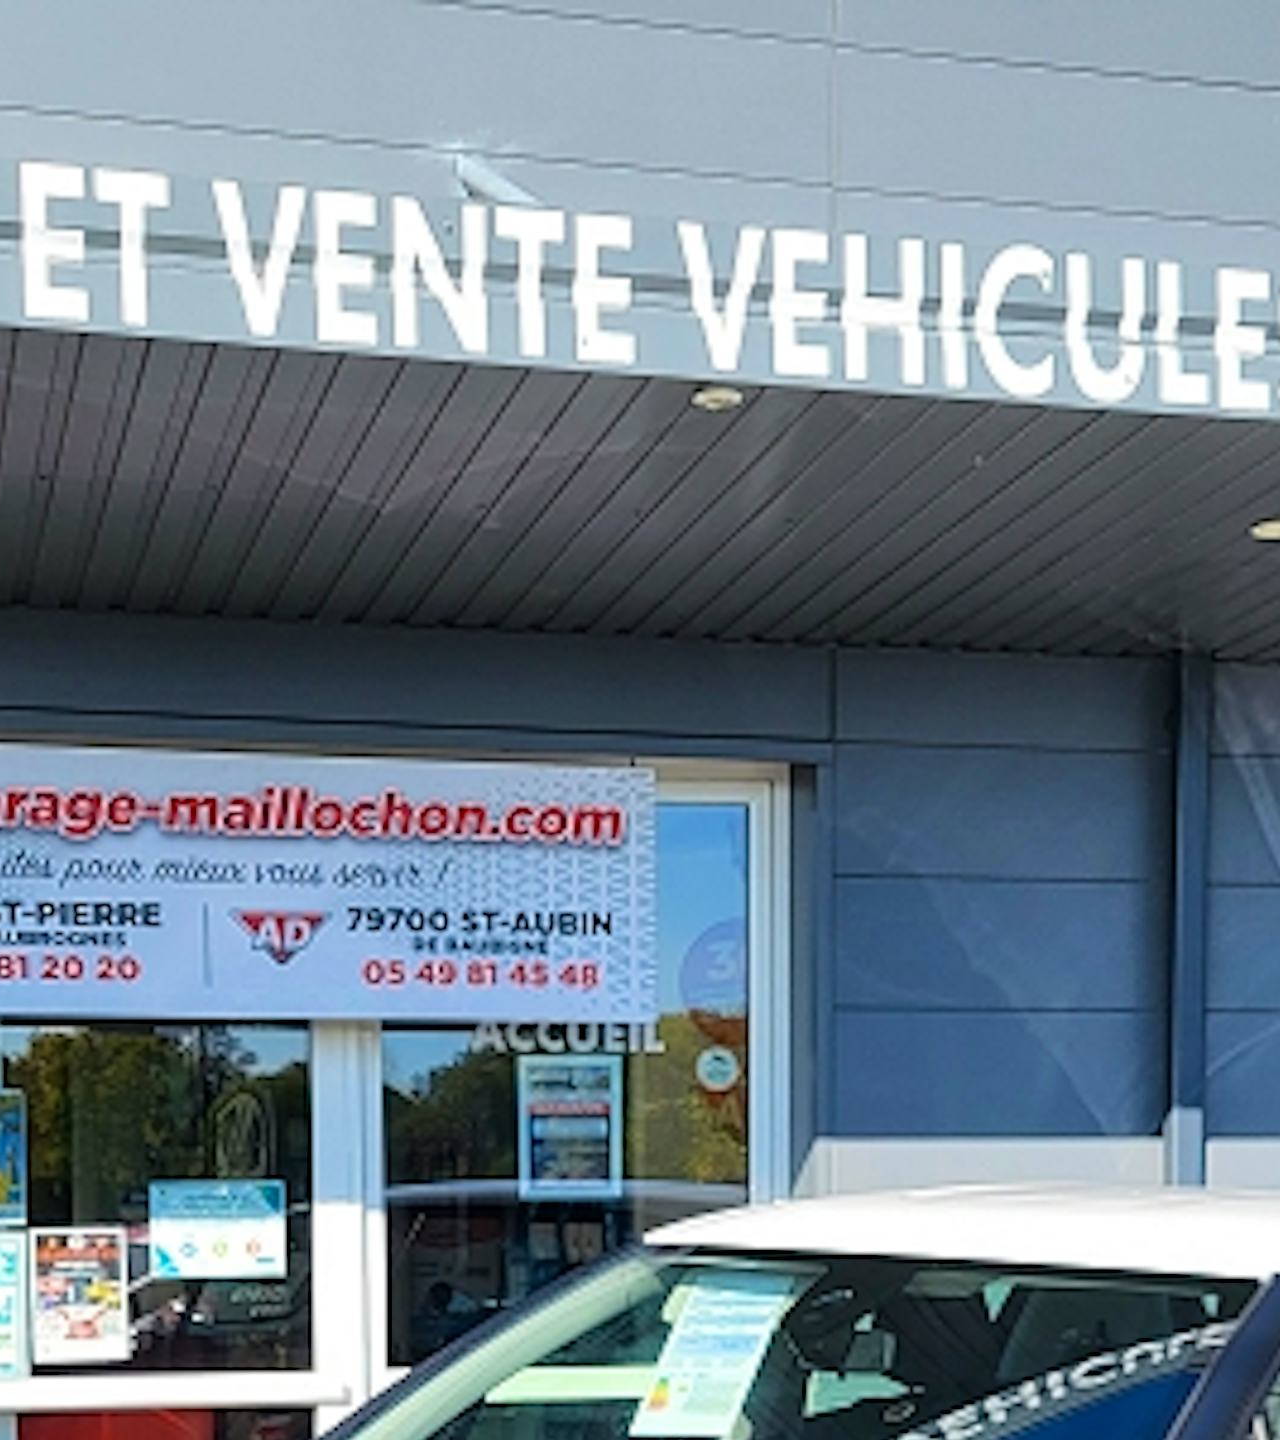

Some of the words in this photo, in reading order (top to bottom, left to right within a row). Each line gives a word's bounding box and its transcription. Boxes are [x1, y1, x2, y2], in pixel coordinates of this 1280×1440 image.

[17, 160, 170, 328] ET
[212, 180, 637, 367] VENTE
[57, 858, 146, 888] pour
[252, 916, 312, 950] AD
[347, 907, 449, 931] 79700
[461, 912, 613, 937] ST-AUBIN
[41, 955, 84, 981] 20
[97, 955, 140, 981] 20
[363, 959, 406, 986] 05
[415, 960, 458, 986] 49
[467, 961, 497, 986] 81
[471, 1020, 666, 1053] ACCUEIL
